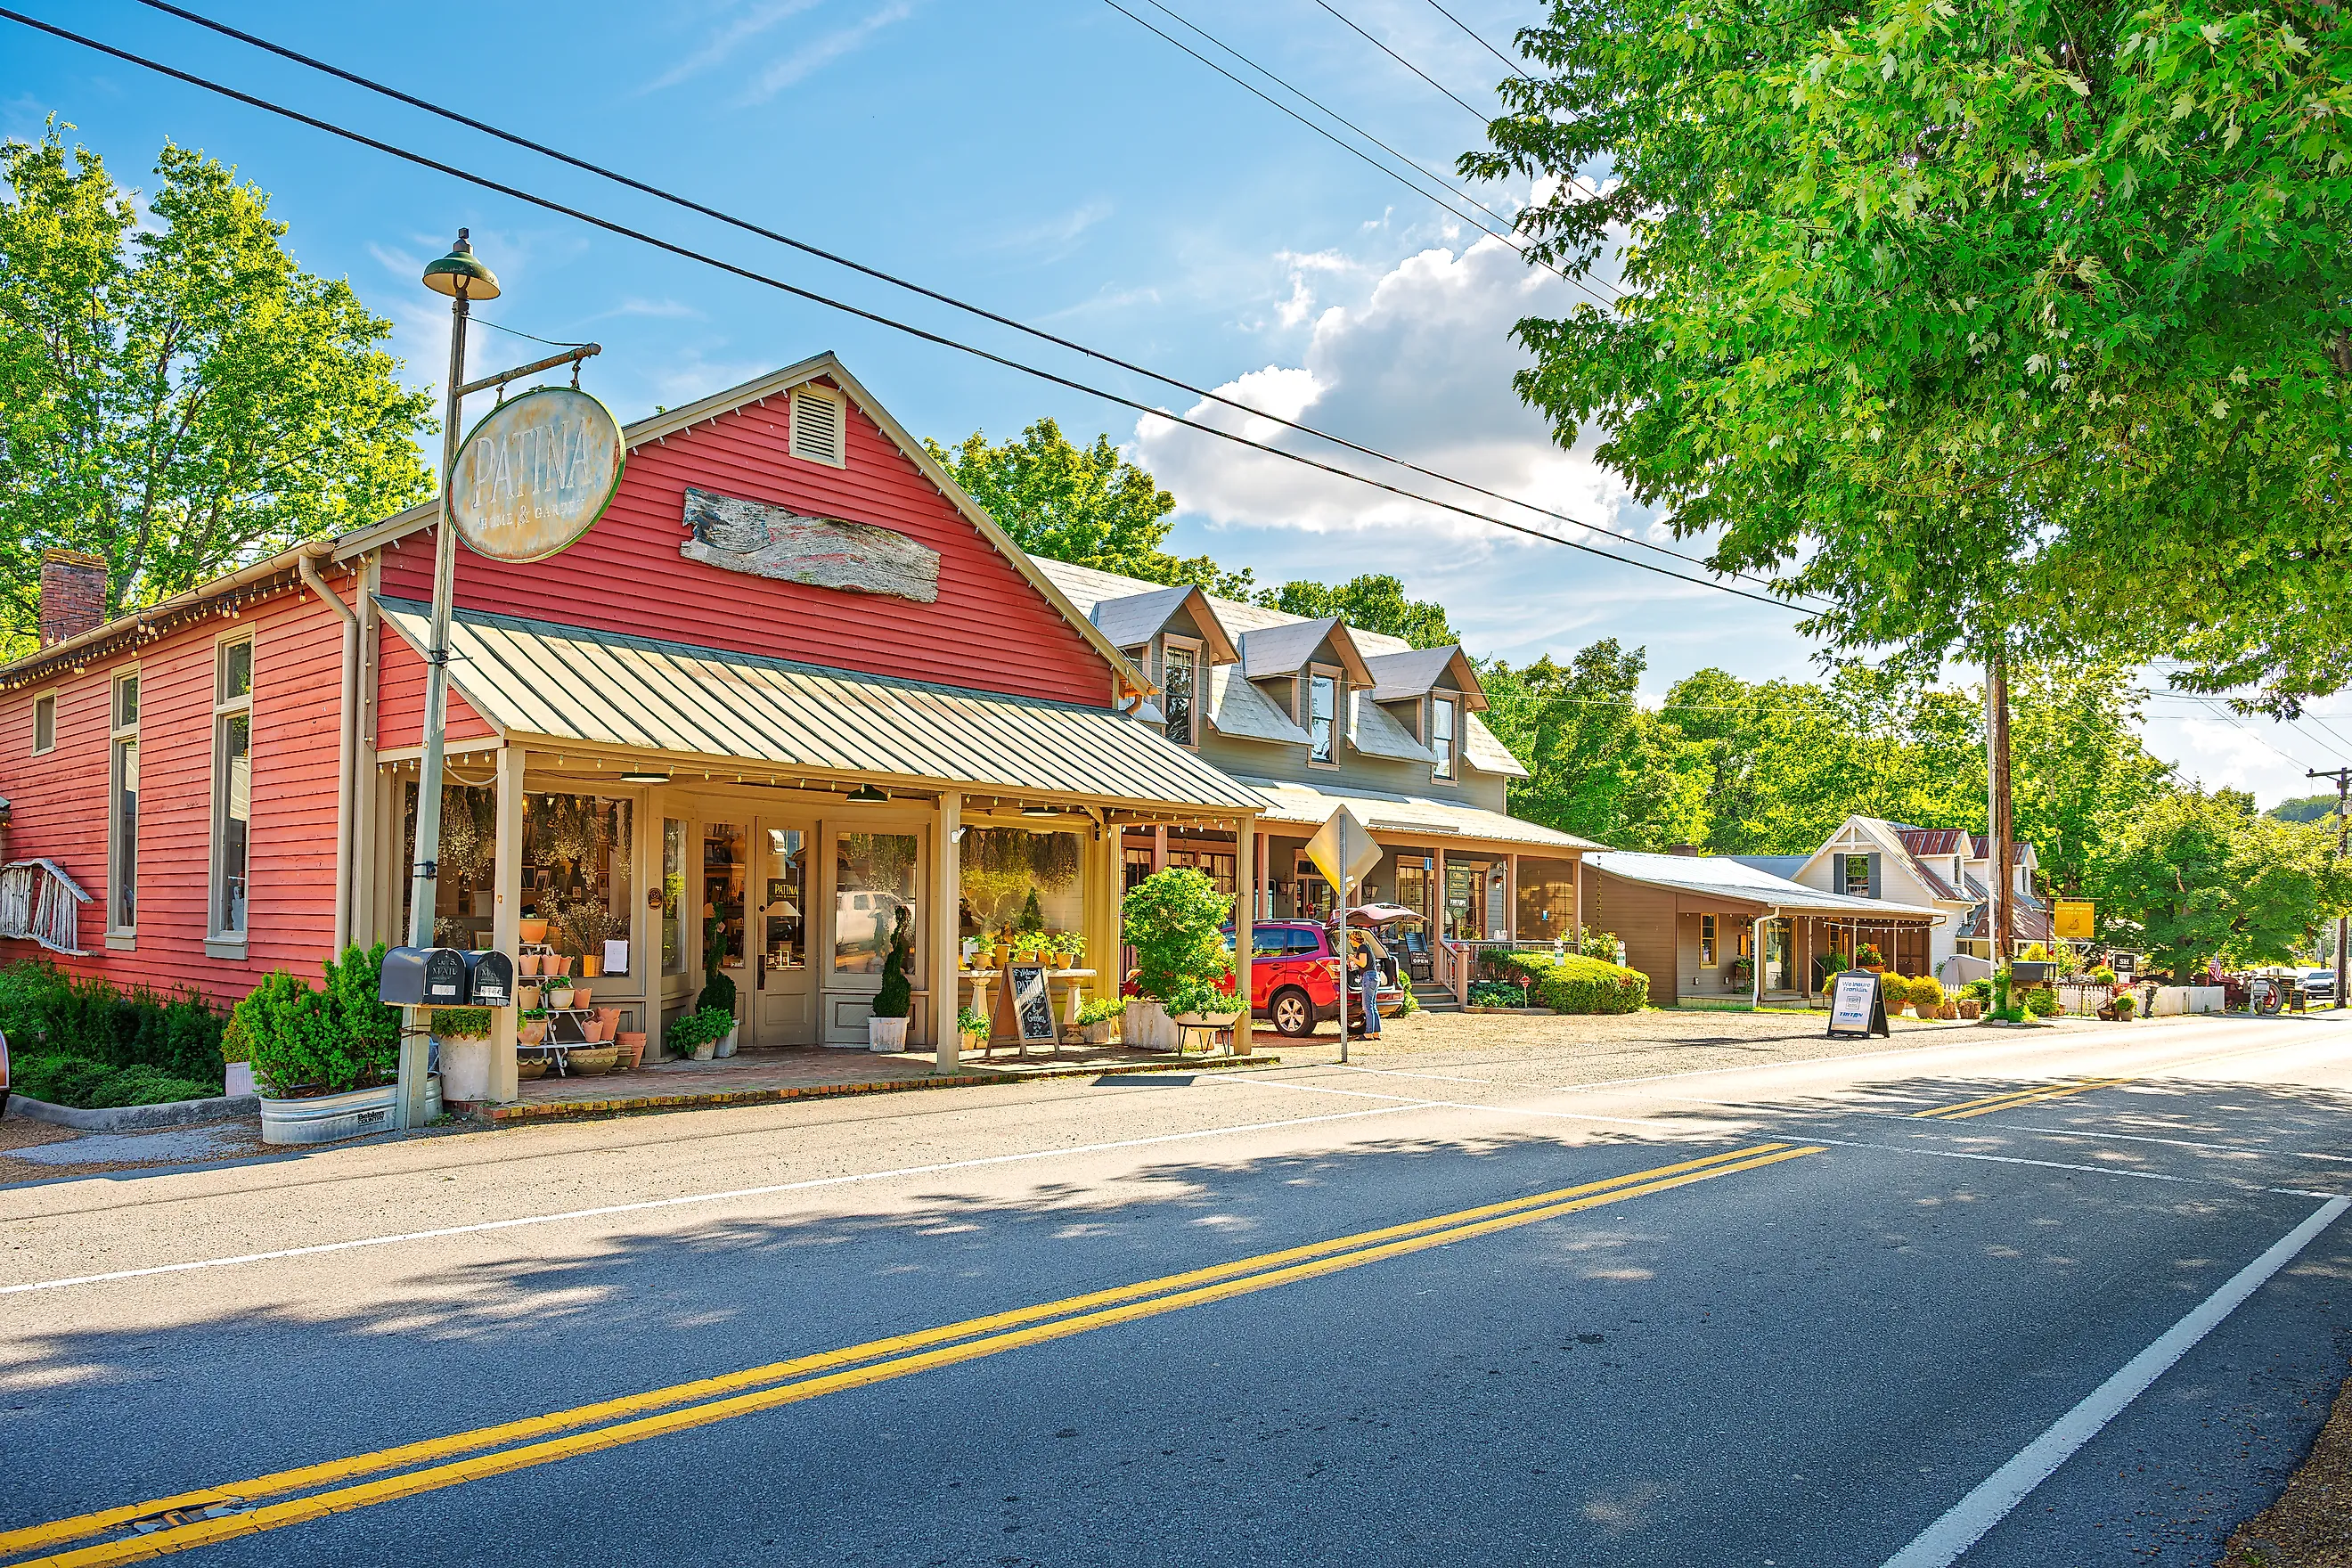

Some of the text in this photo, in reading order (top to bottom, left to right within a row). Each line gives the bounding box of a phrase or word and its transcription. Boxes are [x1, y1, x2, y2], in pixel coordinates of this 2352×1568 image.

[473, 417, 592, 509] PATINA
[479, 513, 512, 530] HOME
[519, 505, 529, 525] &
[775, 883, 799, 895] PATINA
[357, 1111, 384, 1120] Behlen
